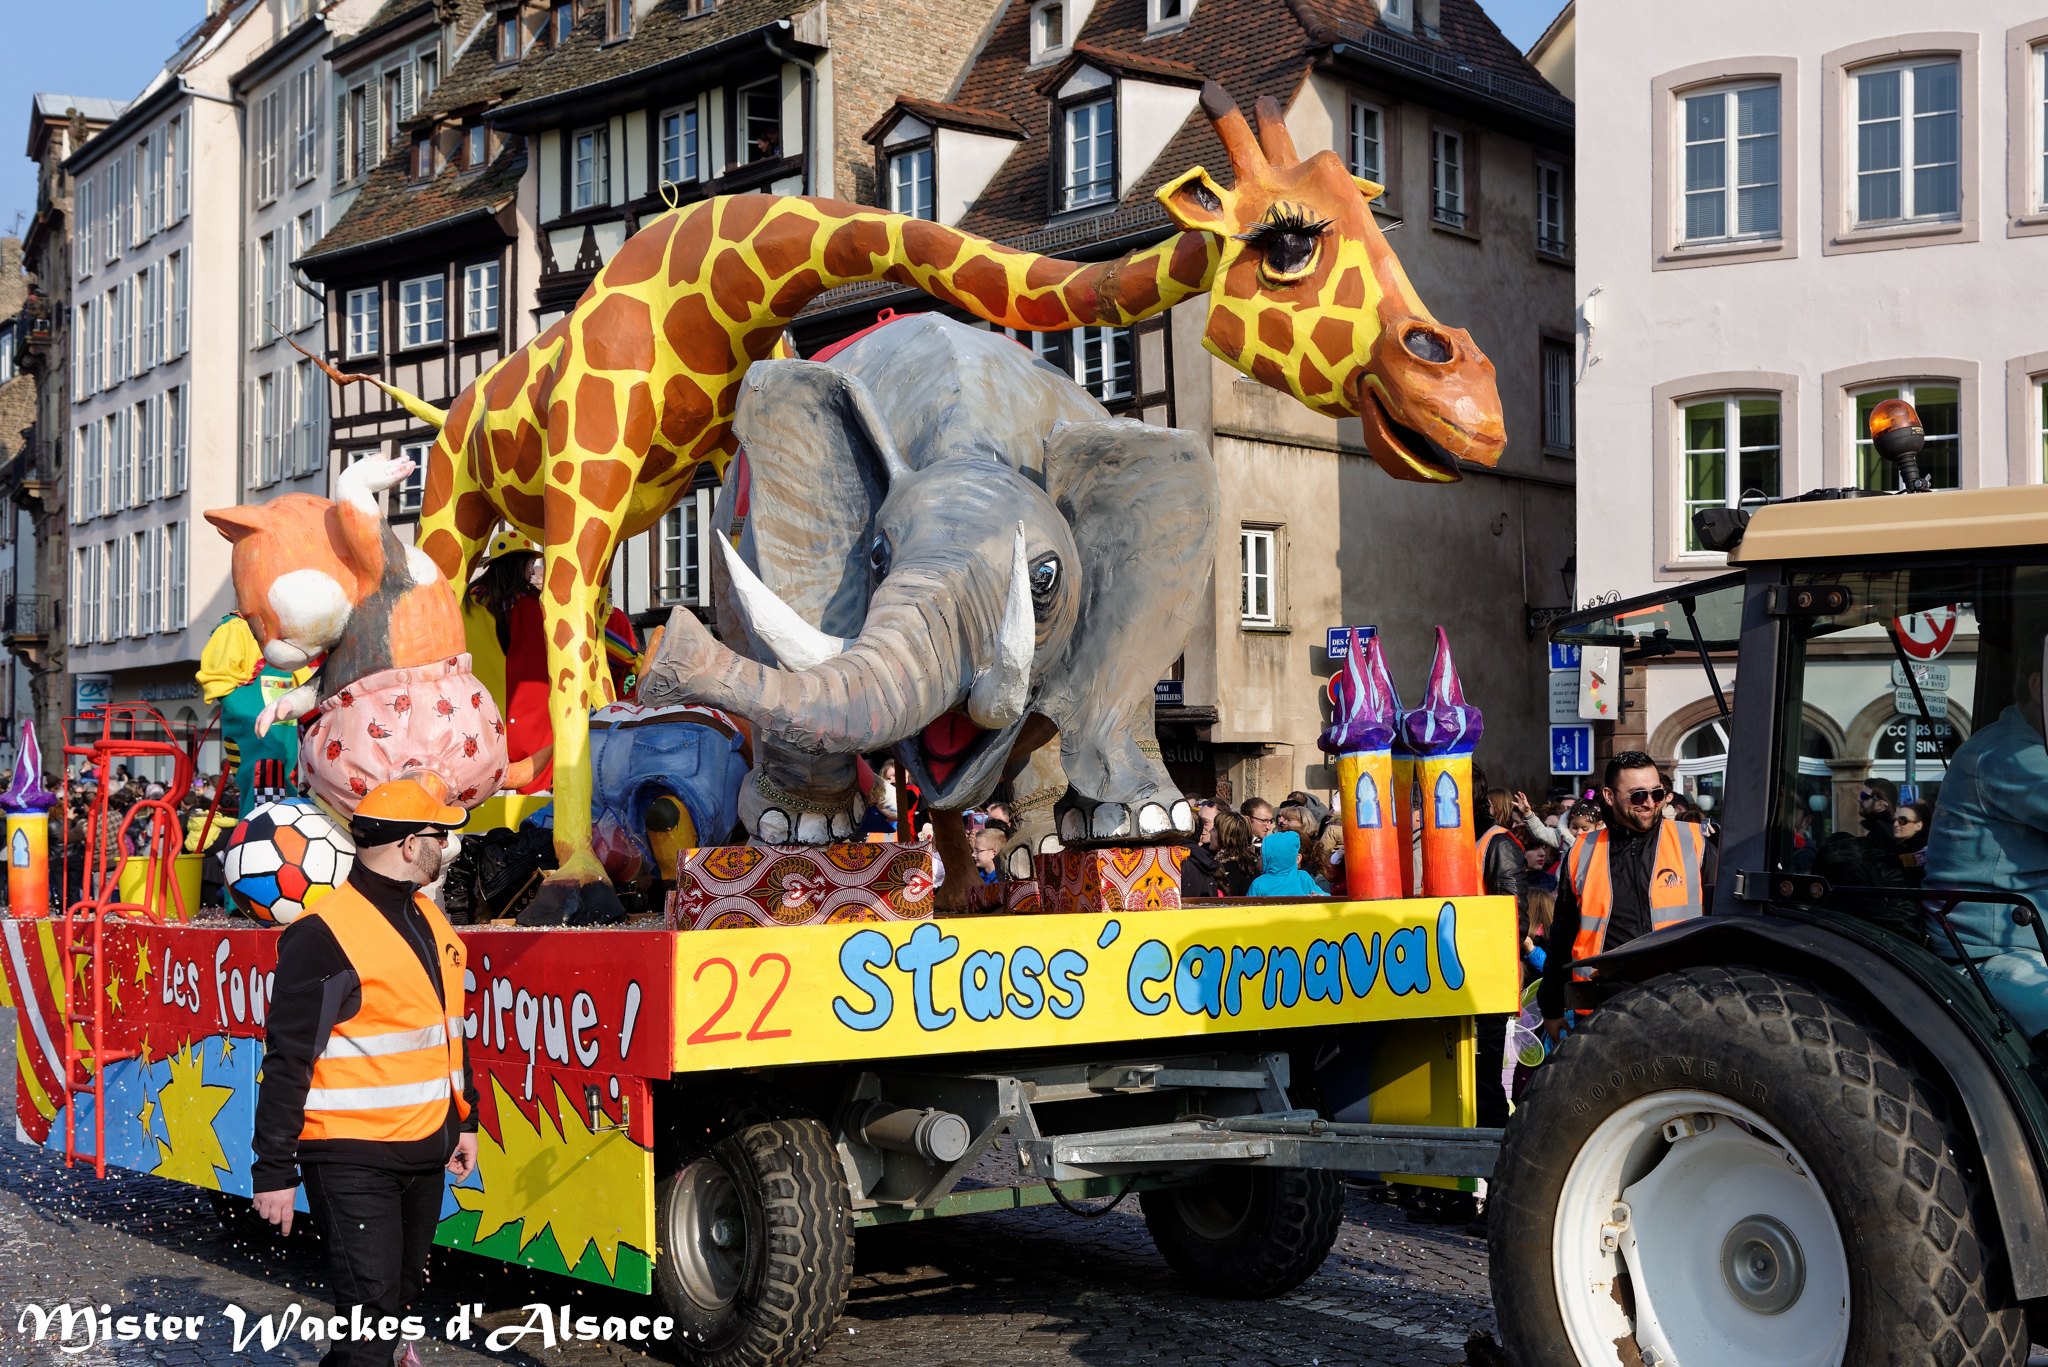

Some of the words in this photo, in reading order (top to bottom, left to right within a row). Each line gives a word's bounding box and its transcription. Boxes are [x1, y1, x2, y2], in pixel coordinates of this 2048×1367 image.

[1886, 724, 1931, 737] CORS
[1935, 724, 1952, 736] DE
[1166, 744, 1204, 763] stub
[162, 945, 200, 1014] Les
[687, 952, 793, 1045] 22
